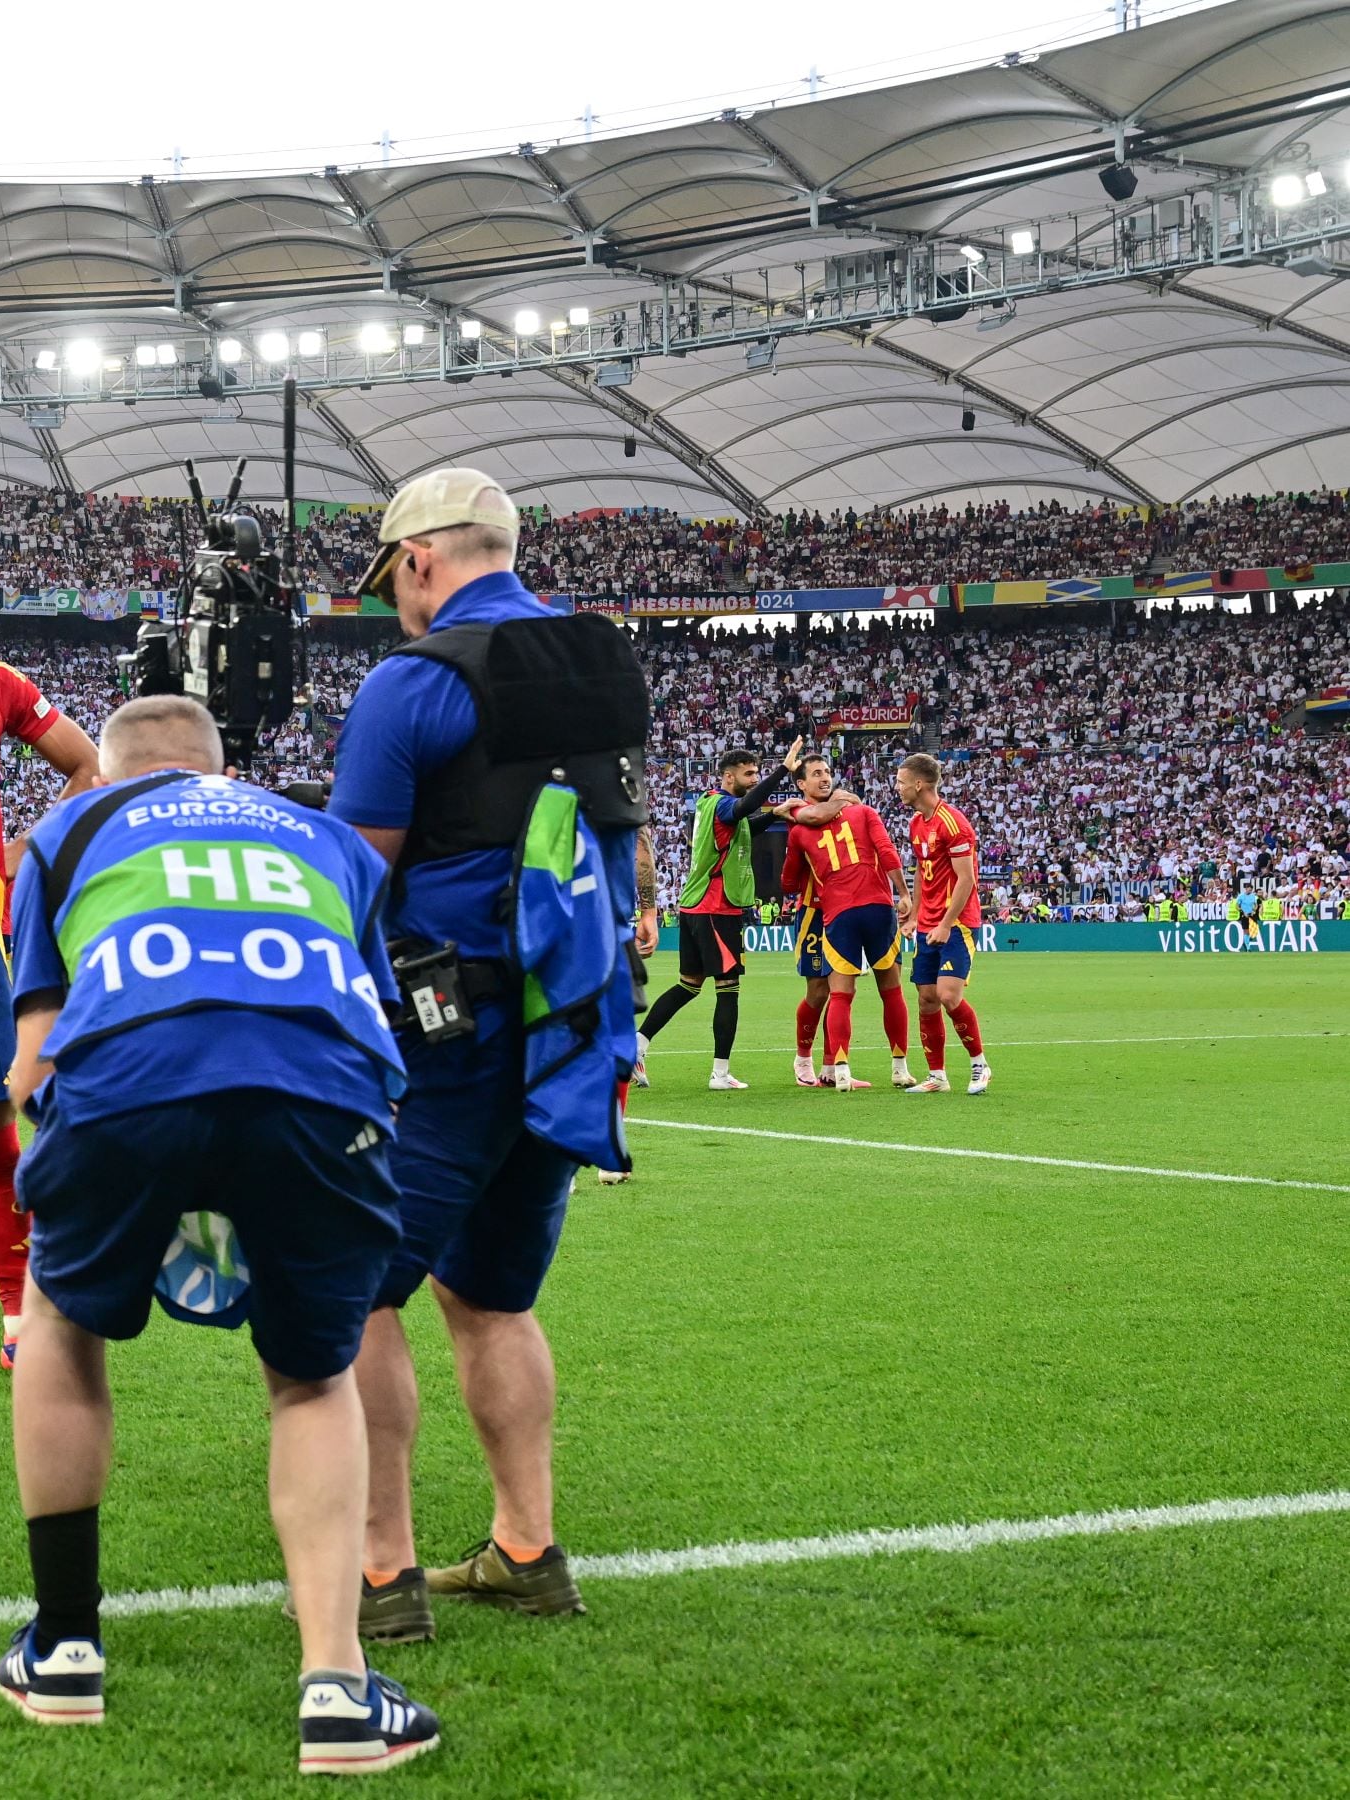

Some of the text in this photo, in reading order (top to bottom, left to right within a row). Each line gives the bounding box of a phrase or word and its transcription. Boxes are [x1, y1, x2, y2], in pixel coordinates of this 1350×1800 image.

[632, 595, 752, 612] HESSENMOB
[172, 815, 278, 834] GERMANY
[817, 821, 860, 872] 11
[160, 848, 311, 908] HB
[921, 860, 934, 881] 10
[744, 926, 794, 952] QATA
[806, 933, 824, 954] 2
[86, 922, 390, 1032] 10-014
